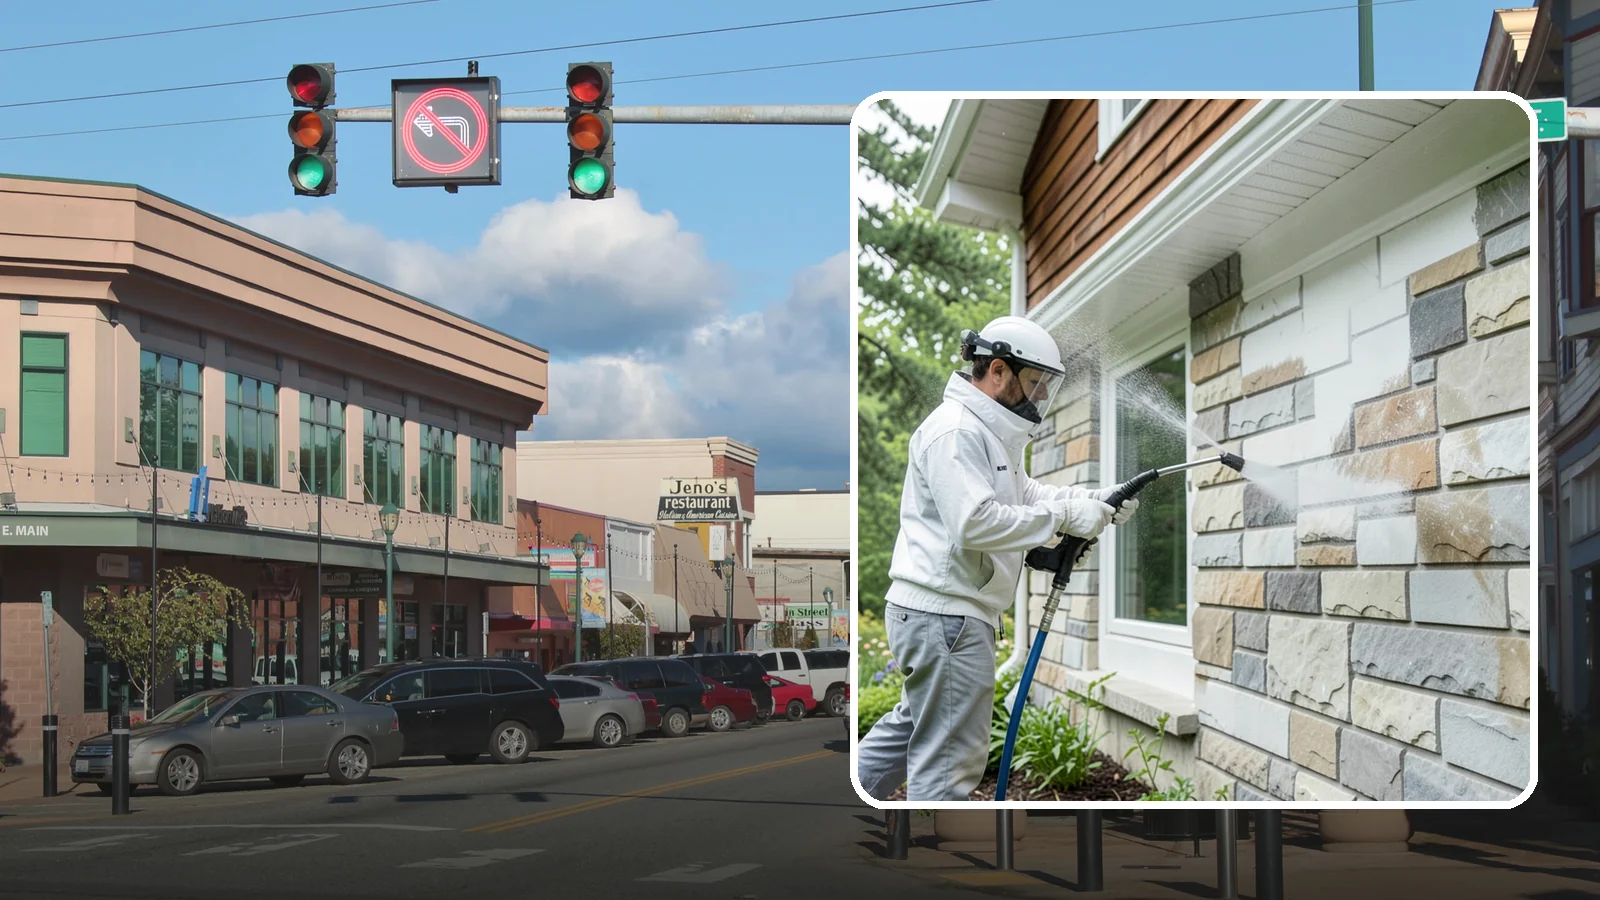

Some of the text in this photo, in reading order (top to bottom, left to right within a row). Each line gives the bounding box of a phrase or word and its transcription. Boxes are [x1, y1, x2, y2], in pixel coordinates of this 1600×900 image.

[669, 480, 728, 495] Jeno's
[665, 496, 731, 509] restaurant
[658, 509, 681, 520] Italian
[686, 509, 715, 520] American
[715, 509, 738, 519] Cuisine
[2, 525, 49, 536] E. MAIN
[797, 607, 829, 617] Street
[788, 619, 824, 627] lass
